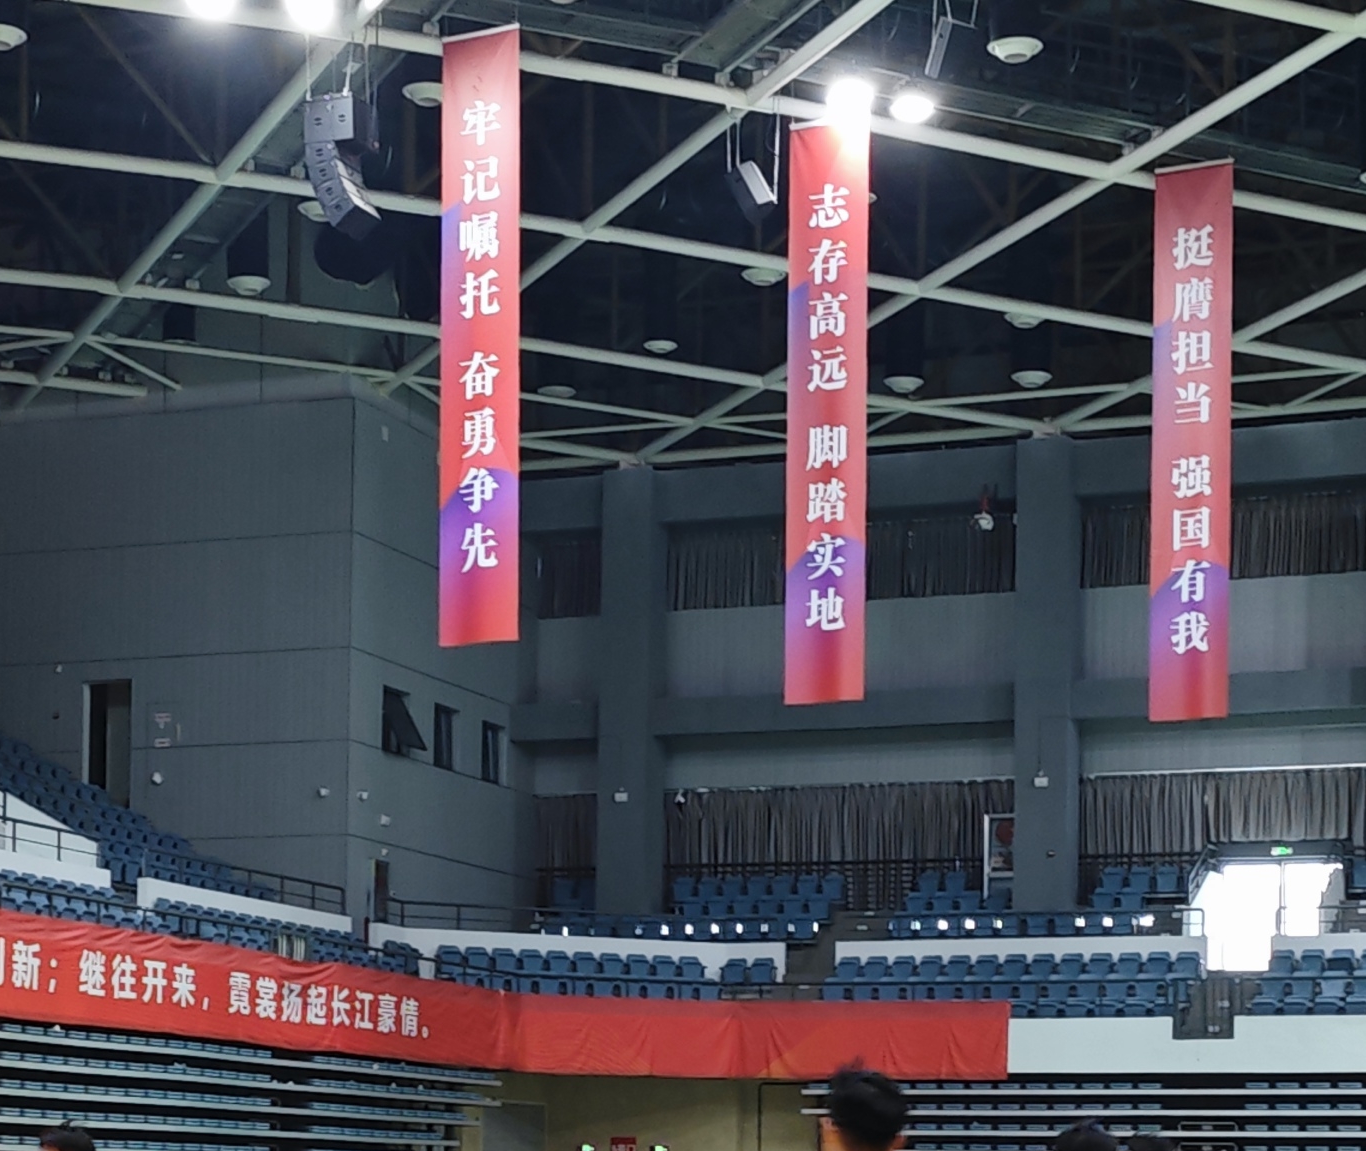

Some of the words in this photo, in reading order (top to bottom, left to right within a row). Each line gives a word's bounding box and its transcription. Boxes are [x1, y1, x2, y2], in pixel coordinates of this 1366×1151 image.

[458, 99, 502, 321] 牢记嘱托
[806, 184, 851, 394] 志存高远
[1170, 224, 1215, 426] 挺膺担当
[458, 352, 501, 574] 奋勇争先
[804, 424, 849, 633] 脚踏实地
[1169, 455, 1214, 656] 强国有我
